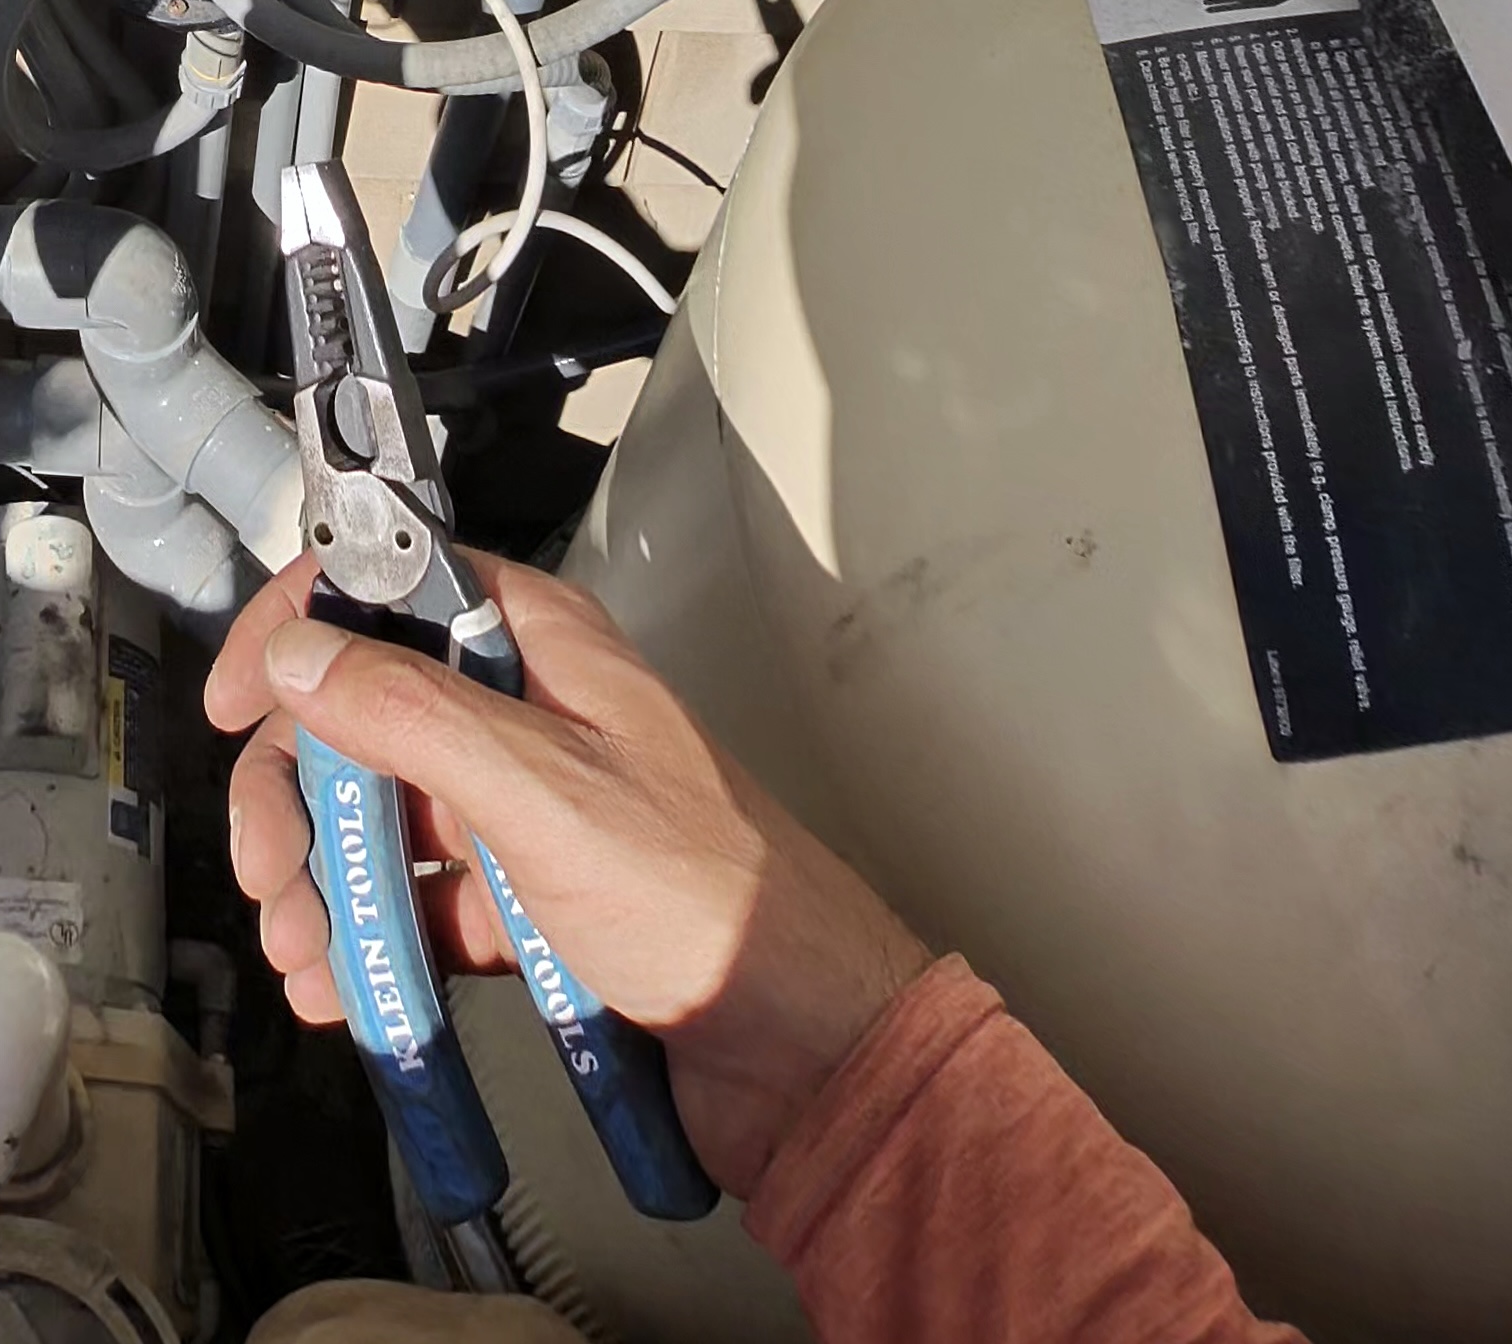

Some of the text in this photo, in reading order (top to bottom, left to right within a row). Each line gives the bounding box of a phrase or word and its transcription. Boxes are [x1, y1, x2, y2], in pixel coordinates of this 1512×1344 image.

[1184, 149, 1206, 188] properly
[1315, 167, 1337, 203] system
[1173, 177, 1195, 221] servicing
[1197, 188, 1220, 232] mounted
[1279, 180, 1301, 222] blocked.
[1303, 196, 1326, 235] startup.
[1209, 232, 1228, 252] and
[1248, 220, 1271, 261] Replace
[1213, 253, 1244, 308] positioned
[1260, 262, 1278, 289] worn
[1346, 264, 1367, 297] follow
[1268, 290, 1282, 303] or
[1358, 298, 1373, 317] the
[1227, 309, 1255, 364] according
[1272, 304, 1297, 356] damaged
[1360, 317, 1385, 360] system
[1244, 365, 1259, 378] to
[1283, 356, 1304, 388] parts
[1377, 292, 1405, 354] installation
[1394, 353, 1423, 423] instructions
[1373, 360, 1395, 399] restart
[1247, 379, 1275, 450] instructions
[1294, 388, 1322, 461] immediately
[1384, 400, 1414, 474] instructions.
[1261, 450, 1289, 504] provided
[1275, 506, 1295, 533] with
[1317, 492, 1337, 534] clamp,
[1281, 534, 1300, 555] the
[1324, 535, 1349, 592] pressure
[1285, 557, 1305, 591] filter.
[1347, 639, 1367, 672] relief
[335, 779, 425, 1073] KLEIN TOOLS
[521, 928, 600, 1075] TOOLS
